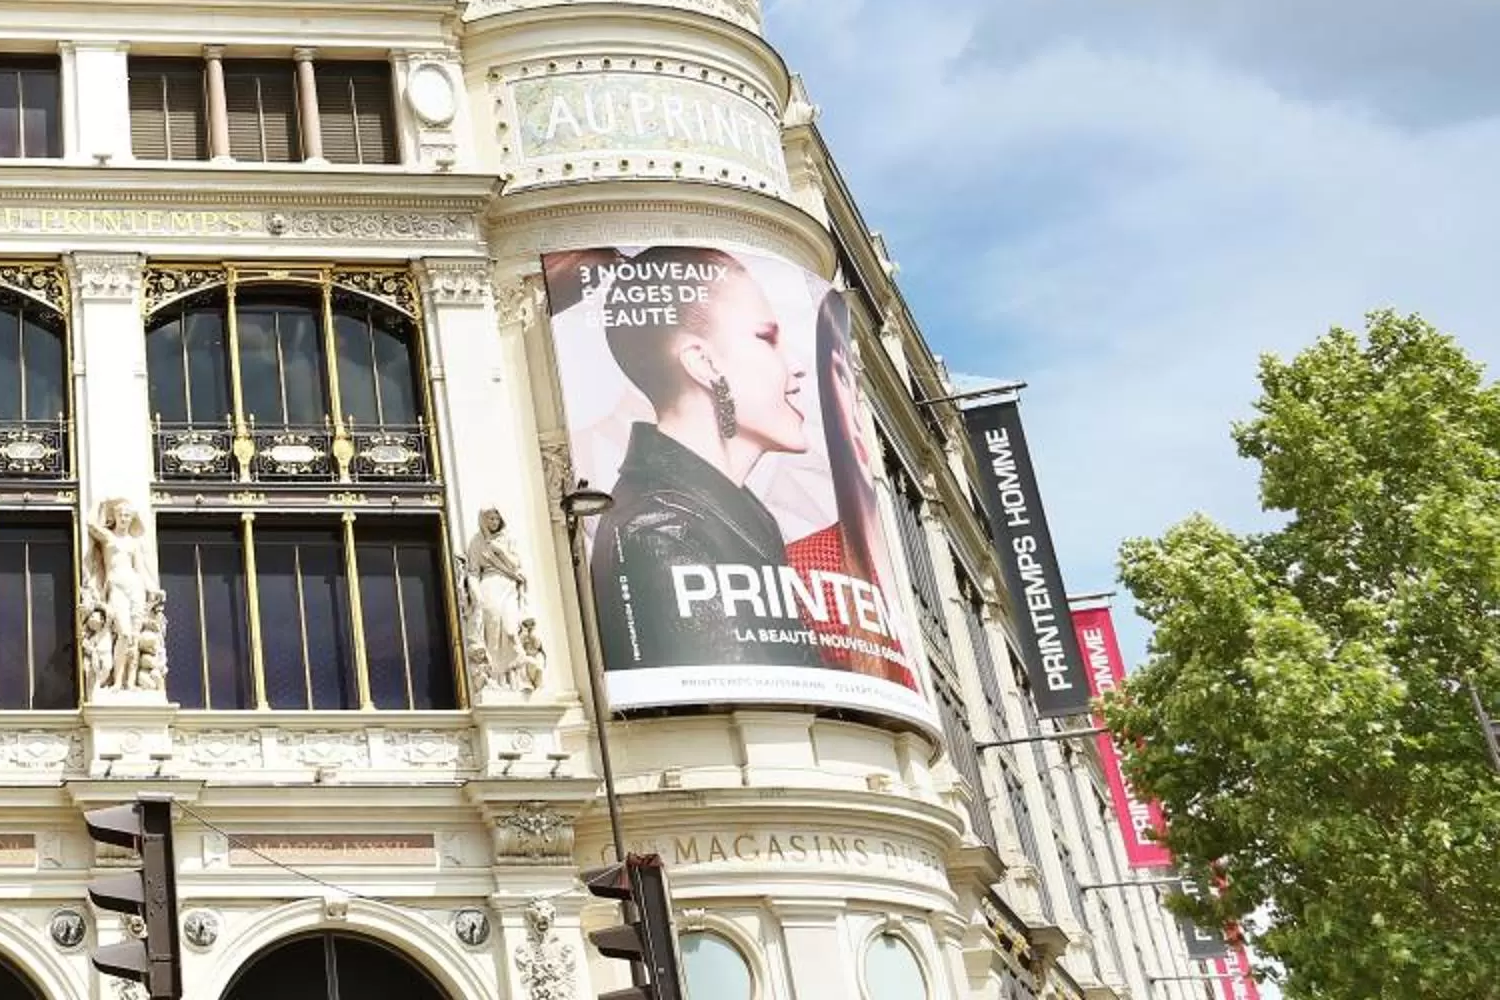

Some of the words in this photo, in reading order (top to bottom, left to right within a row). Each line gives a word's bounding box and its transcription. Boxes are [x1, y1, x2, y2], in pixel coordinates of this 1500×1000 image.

[545, 89, 612, 140] AU
[39, 209, 243, 234] PRINTEMPS
[579, 265, 591, 283] 3
[597, 262, 729, 282] NOUVEAUX
[678, 285, 709, 303] DE
[587, 304, 679, 327] EAUTÉ
[985, 426, 1030, 528] HOMME
[1013, 535, 1073, 691] PRINTEMPS
[733, 628, 757, 642] LA
[758, 628, 818, 646] BEAUTÉ
[673, 832, 870, 867] MAGASINS
